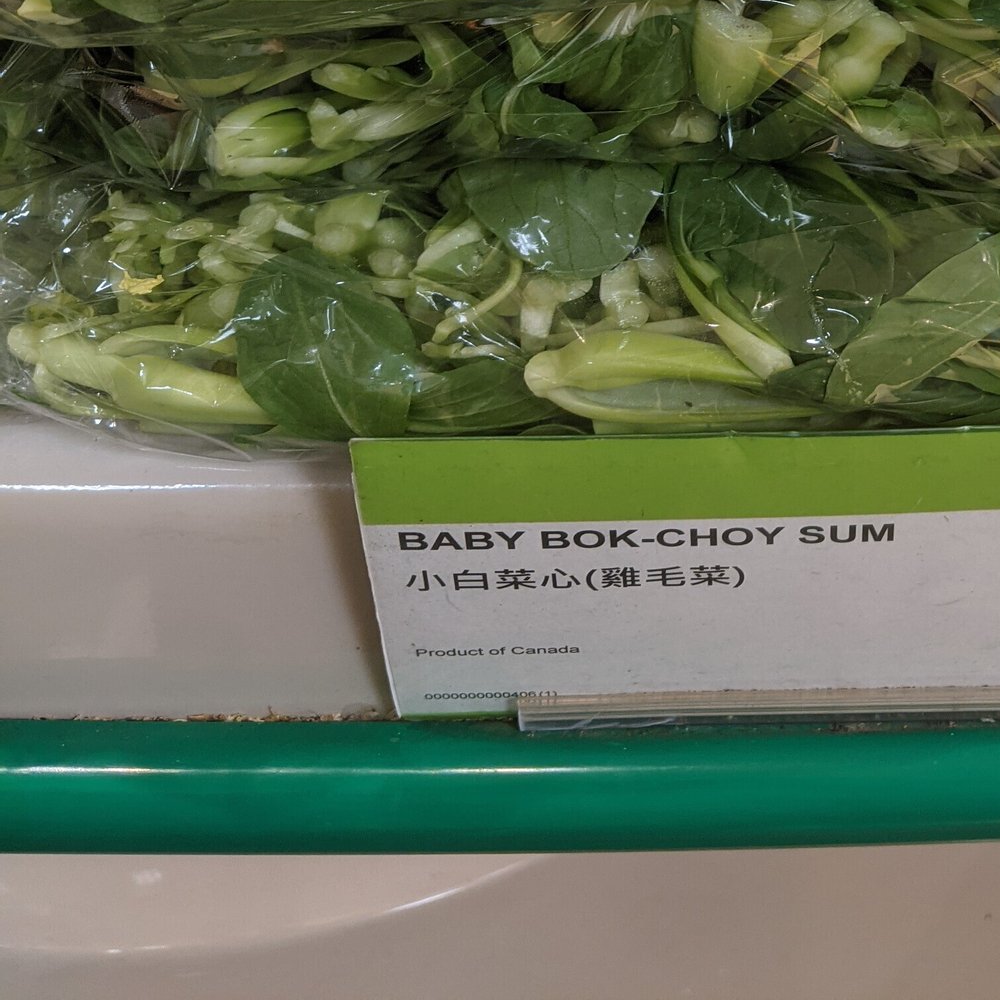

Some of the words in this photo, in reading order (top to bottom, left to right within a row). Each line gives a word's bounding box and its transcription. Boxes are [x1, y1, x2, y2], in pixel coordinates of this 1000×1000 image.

[398, 530, 526, 551] BABY
[541, 527, 786, 549] BOK-CHOY
[798, 523, 895, 545] SUM
[406, 564, 746, 592] 小白菜心(雞毛菜)
[415, 646, 485, 658] Product
[489, 646, 507, 657] of
[511, 644, 581, 656] Canada
